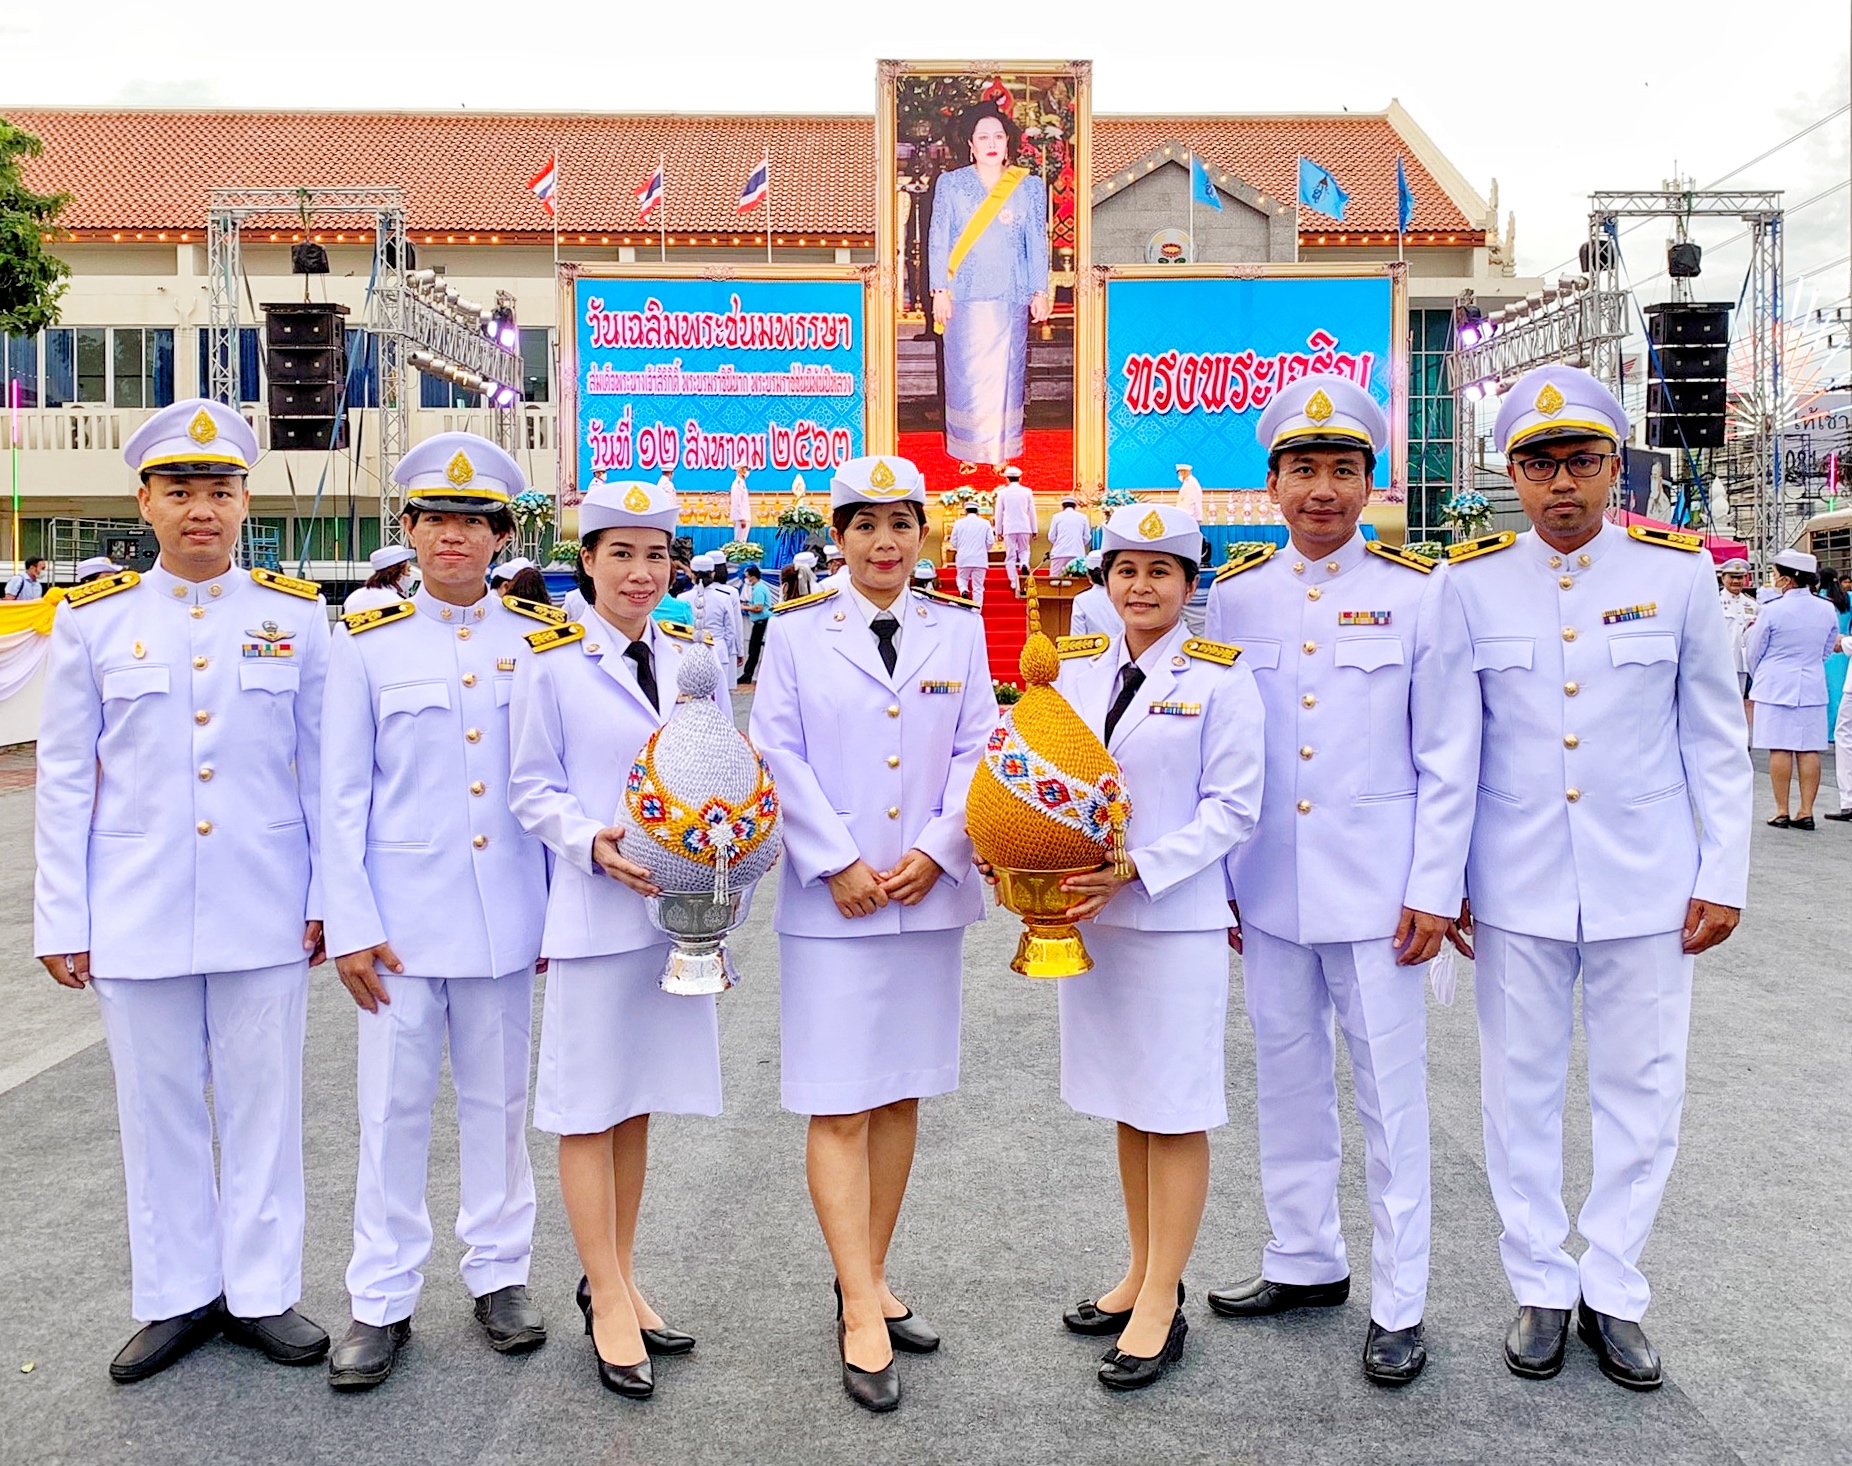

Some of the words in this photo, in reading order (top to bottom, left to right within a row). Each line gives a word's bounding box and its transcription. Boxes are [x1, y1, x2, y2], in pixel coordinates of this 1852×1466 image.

[589, 404, 632, 468] วันที่
[639, 422, 678, 469] ๑๒
[684, 420, 766, 469] สิงหาคม
[770, 420, 852, 470] ๒๕๖๓
